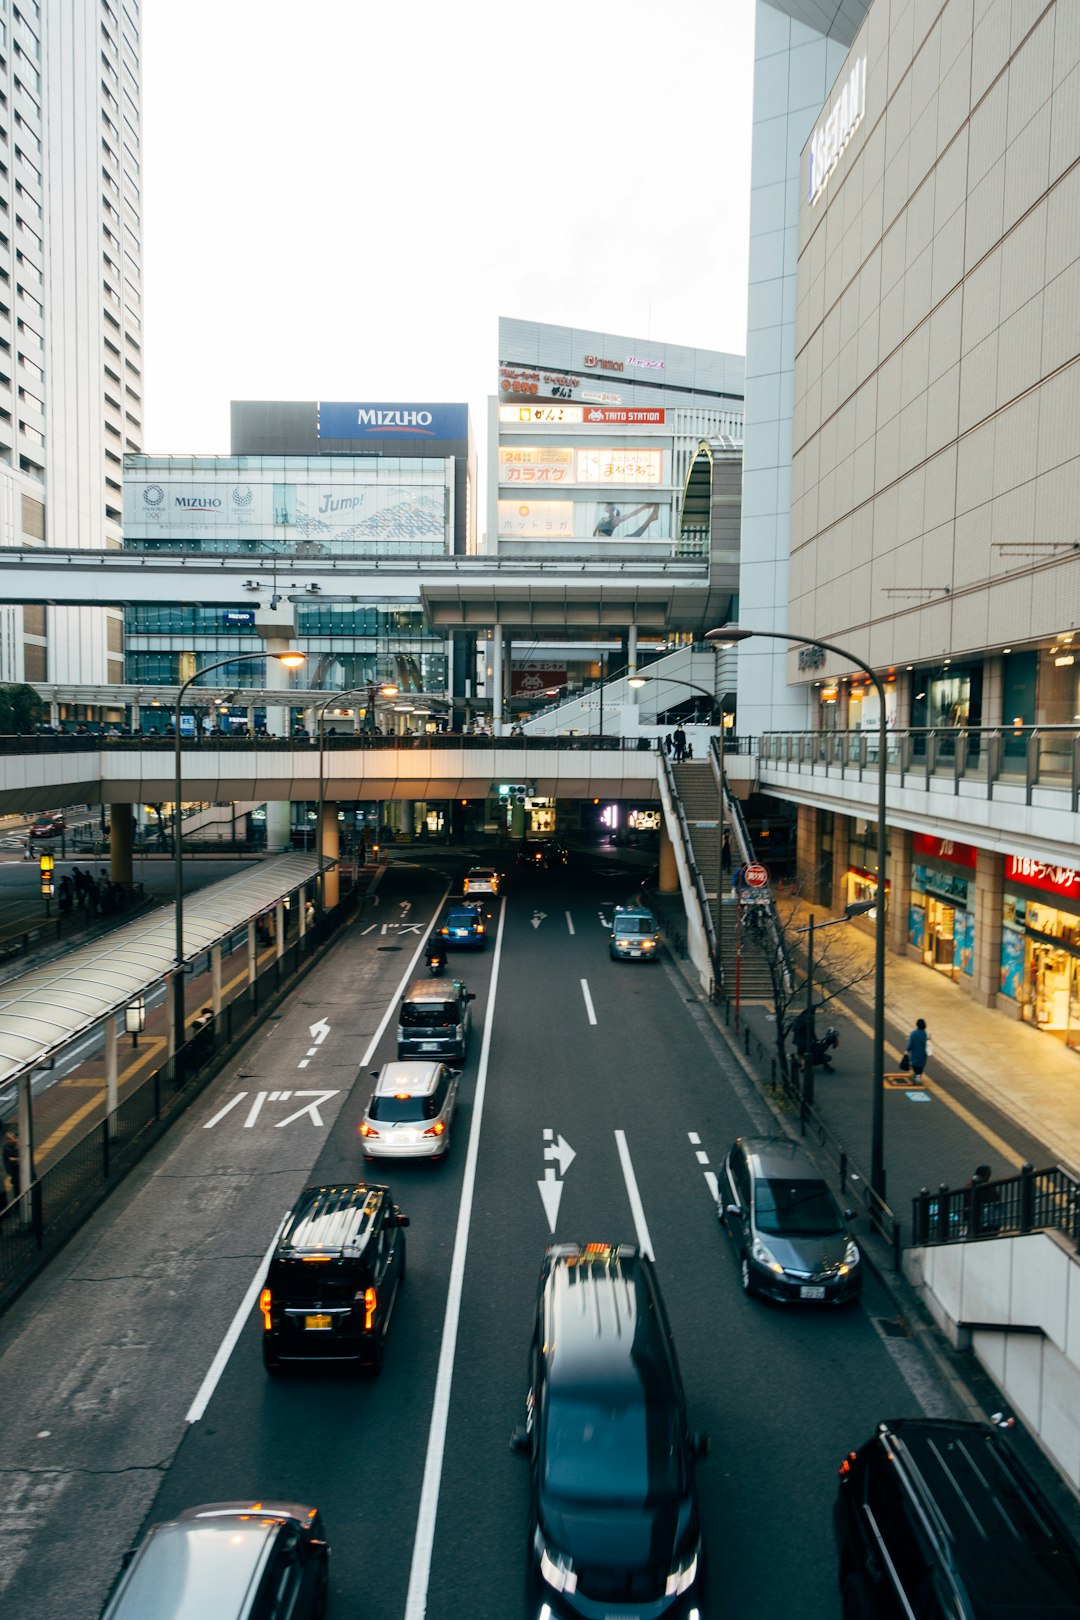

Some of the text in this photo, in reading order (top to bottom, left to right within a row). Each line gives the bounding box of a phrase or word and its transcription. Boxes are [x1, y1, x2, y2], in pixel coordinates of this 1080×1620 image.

[357, 409, 433, 426] MIZUHO
[534, 409, 563, 421] がんこ
[605, 410, 660, 420] TAITO STATION
[507, 467, 566, 481] カラオケ
[603, 464, 656, 476] まねきねこ
[175, 497, 222, 507] MIZUHO
[318, 493, 364, 514] Jump!
[503, 521, 568, 531] ホットヨガ
[360, 922, 426, 936] バス
[203, 1090, 340, 1128] バス
